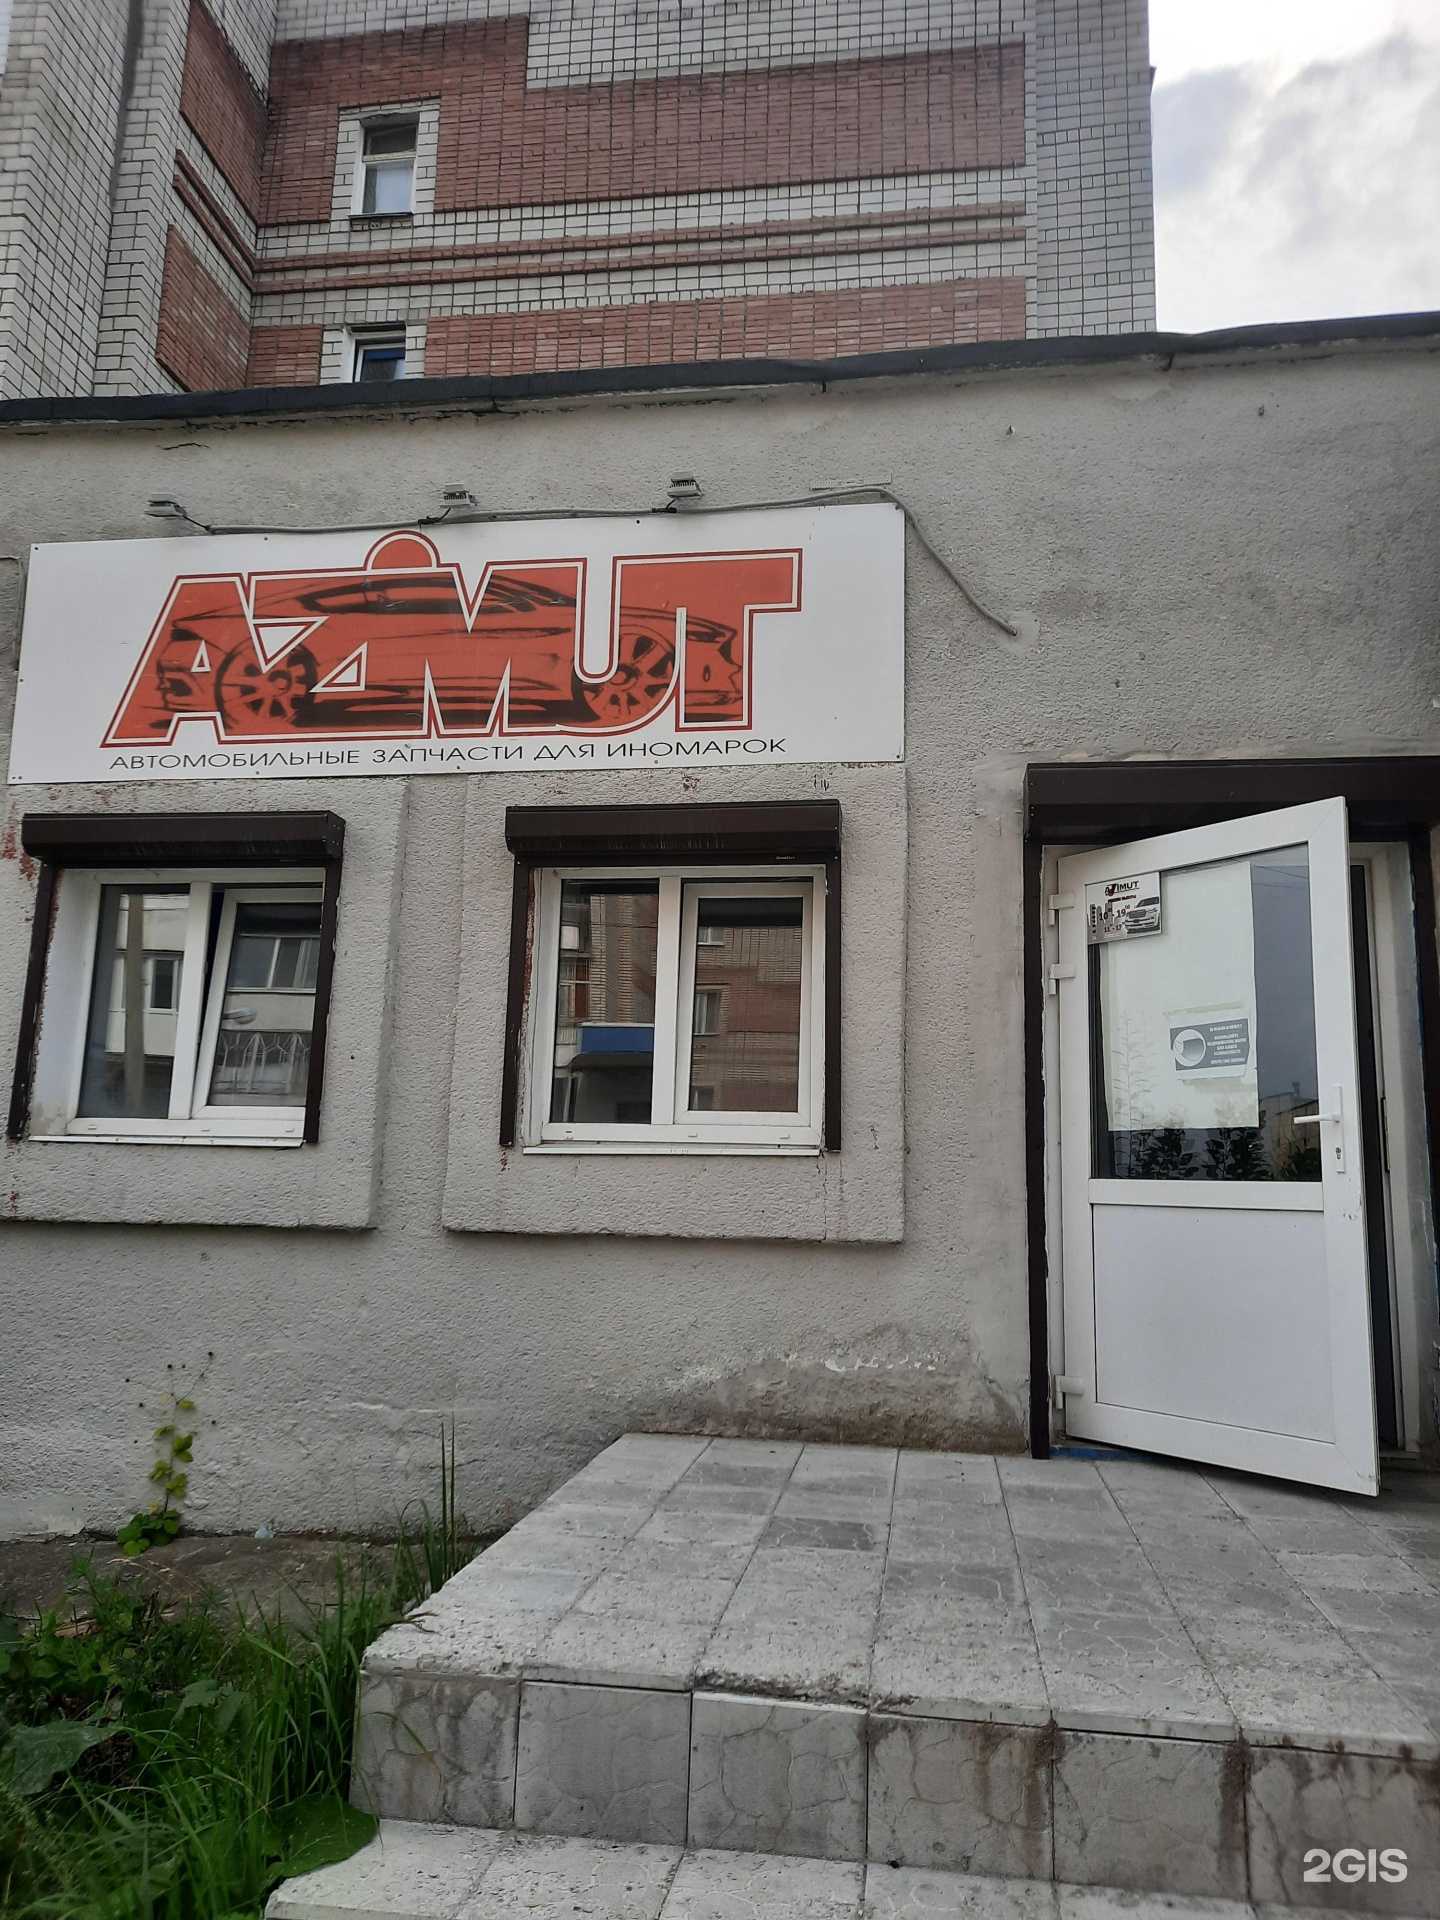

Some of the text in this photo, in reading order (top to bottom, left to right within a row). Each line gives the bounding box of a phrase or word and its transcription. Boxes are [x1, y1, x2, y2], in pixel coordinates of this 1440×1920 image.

[109, 738, 786, 770] АВТОМОБИЛЬНЫЕ ЗАПЧАСТИ ДЛЯ ИНОМАРОК
